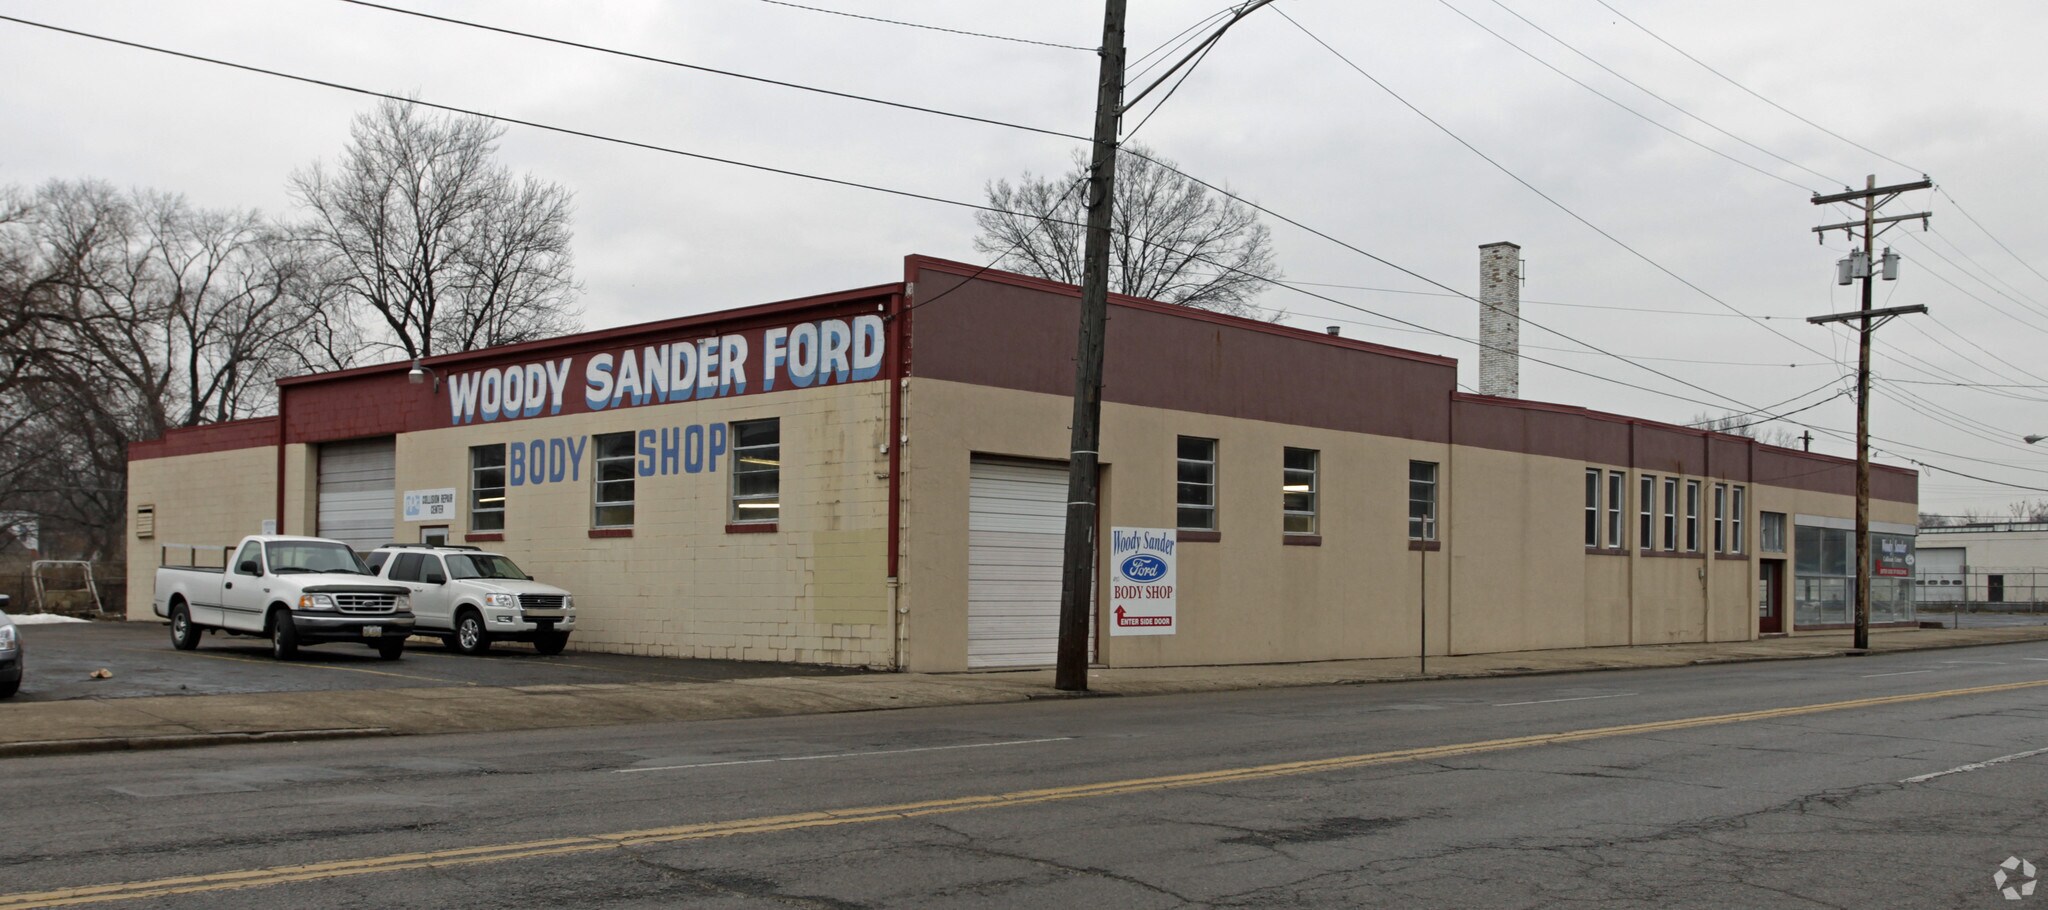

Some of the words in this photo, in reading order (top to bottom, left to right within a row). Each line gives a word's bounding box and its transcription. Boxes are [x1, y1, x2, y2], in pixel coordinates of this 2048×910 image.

[448, 358, 573, 425] WOODY
[586, 333, 749, 411] SANDER
[763, 314, 885, 392] FORD
[510, 435, 588, 487] BODY
[638, 422, 727, 477] SHOP
[1113, 530, 1142, 556] Woody
[1143, 531, 1175, 556] Sander
[1129, 557, 1159, 577] Ford
[1114, 585, 1143, 599] BODY
[1145, 585, 1173, 599] SHOP
[1121, 618, 1139, 626] ENTER
[1154, 617, 1170, 625] DOOR
